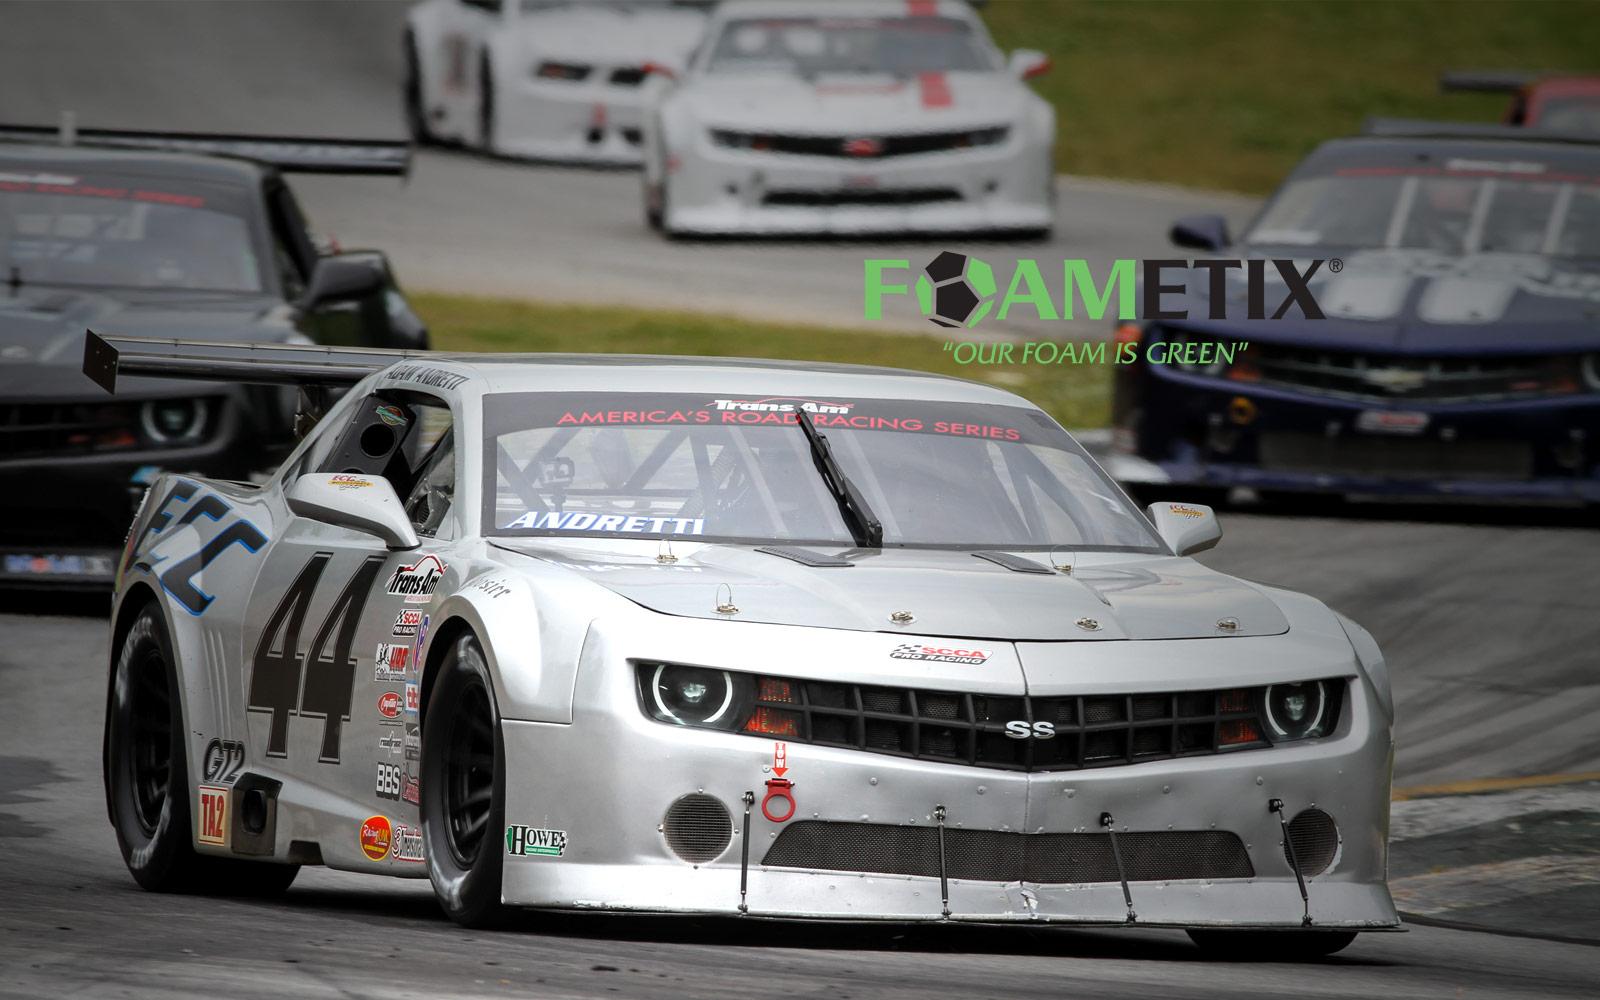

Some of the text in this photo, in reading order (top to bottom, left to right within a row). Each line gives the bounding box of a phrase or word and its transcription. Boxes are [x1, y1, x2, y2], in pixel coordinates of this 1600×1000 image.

[415, 366, 470, 391] ANDRETTI
[715, 399, 849, 414] Trans Am
[556, 409, 1021, 441] AMERICA'S ROAD RACING SERIES
[505, 510, 706, 536] ANDRETTI
[247, 552, 387, 765] 44
[891, 652, 983, 665] PRO RACING
[920, 646, 986, 658] SCCA
[1004, 720, 1056, 740] SS
[203, 738, 246, 785] GT2
[376, 763, 401, 798] BBS
[201, 793, 225, 838] TA2
